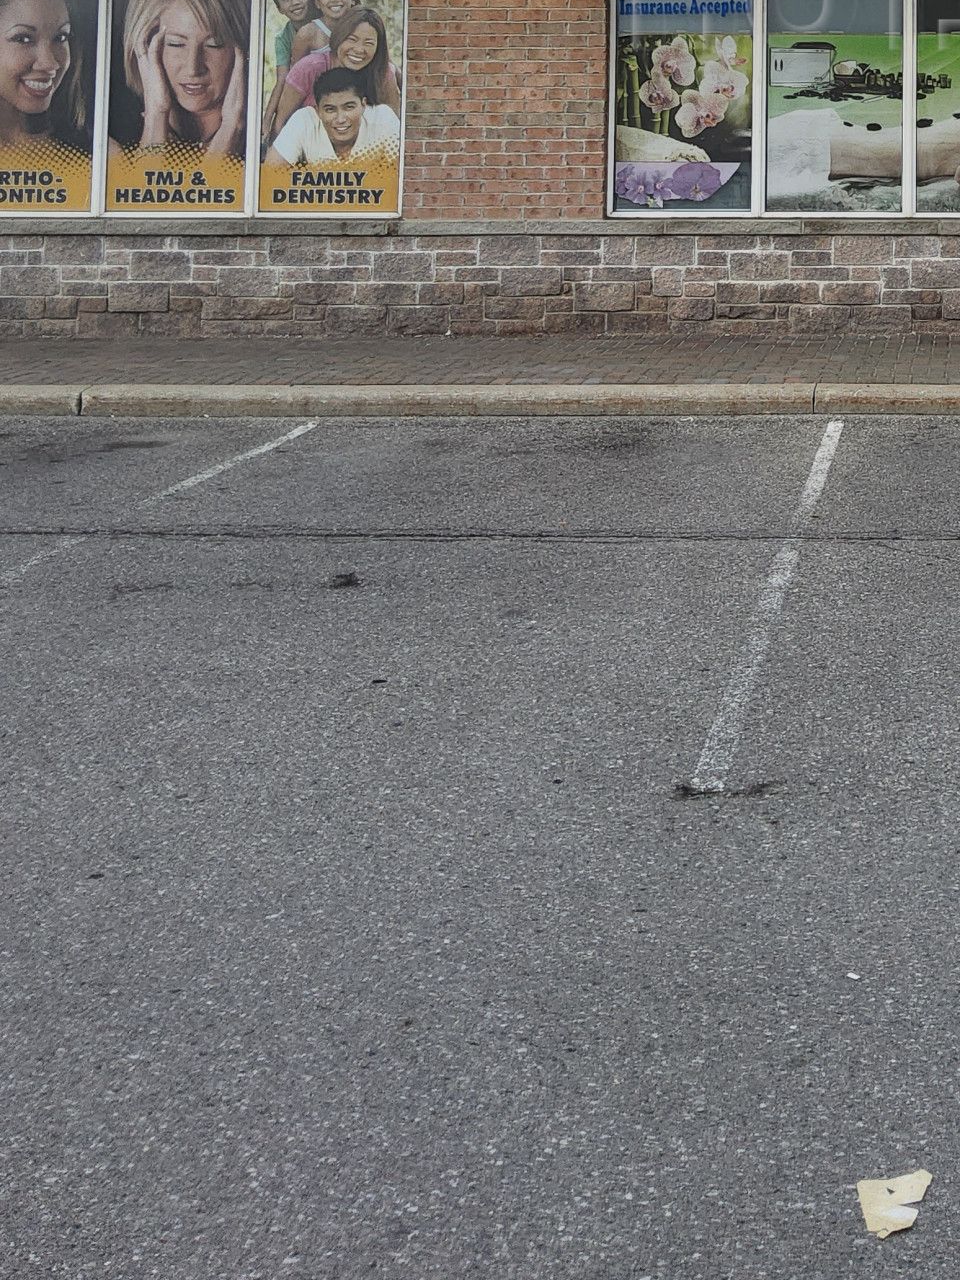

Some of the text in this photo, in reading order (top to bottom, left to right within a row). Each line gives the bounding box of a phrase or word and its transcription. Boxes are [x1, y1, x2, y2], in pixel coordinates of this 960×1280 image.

[619, 0, 687, 15] Insurance
[145, 171, 206, 186] TMJ &
[292, 171, 366, 186] FAMILY
[115, 189, 236, 204] HEADACHES
[272, 189, 384, 204] DENTISTRY
